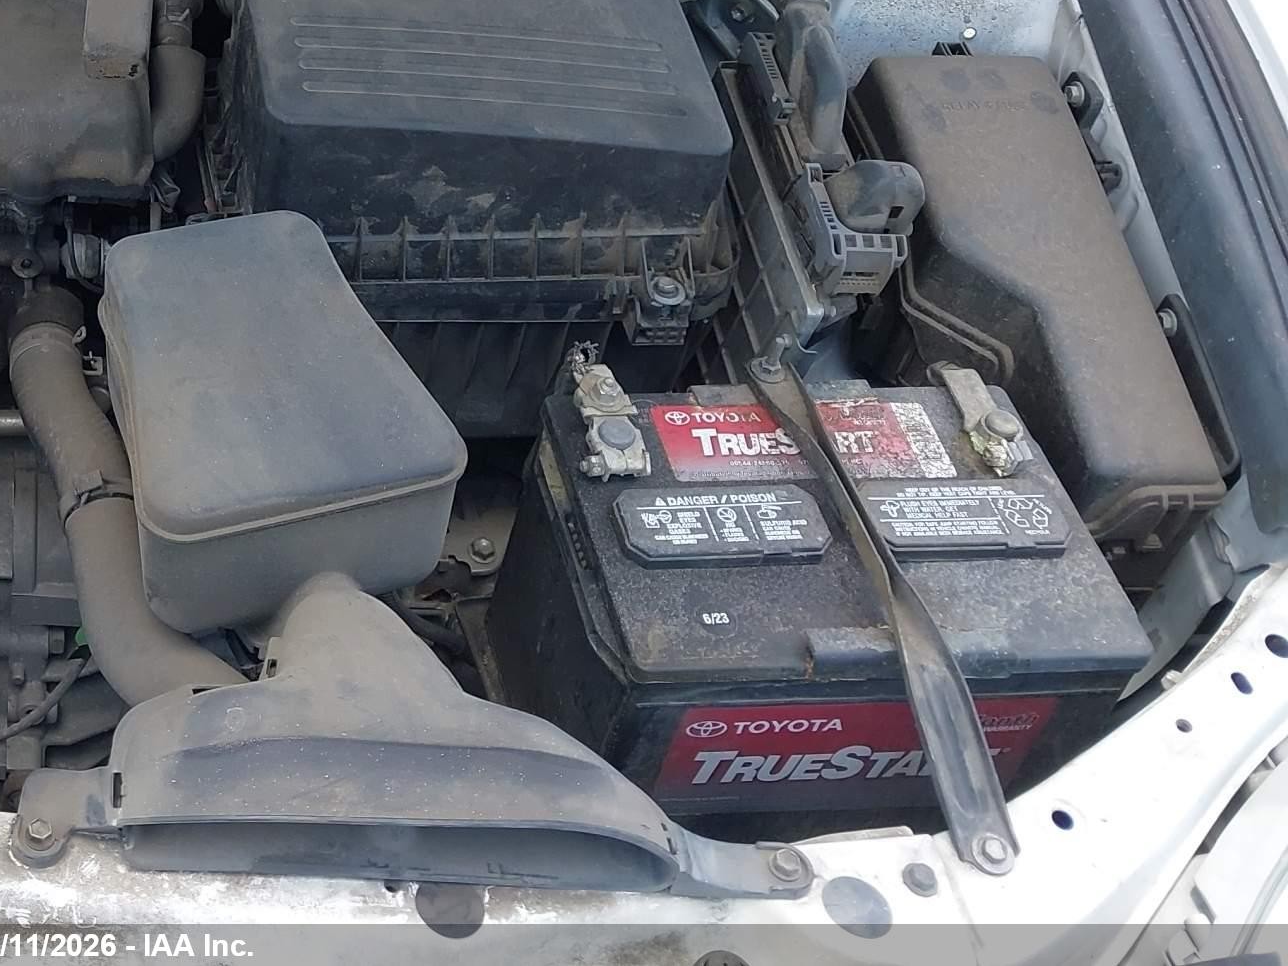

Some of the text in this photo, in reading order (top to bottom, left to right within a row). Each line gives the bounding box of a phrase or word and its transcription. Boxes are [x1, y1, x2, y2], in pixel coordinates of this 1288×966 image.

[667, 496, 718, 506] DANGER
[730, 493, 777, 503] POISON
[702, 612, 730, 625] 6/23
[734, 719, 843, 735] TOYOTA
